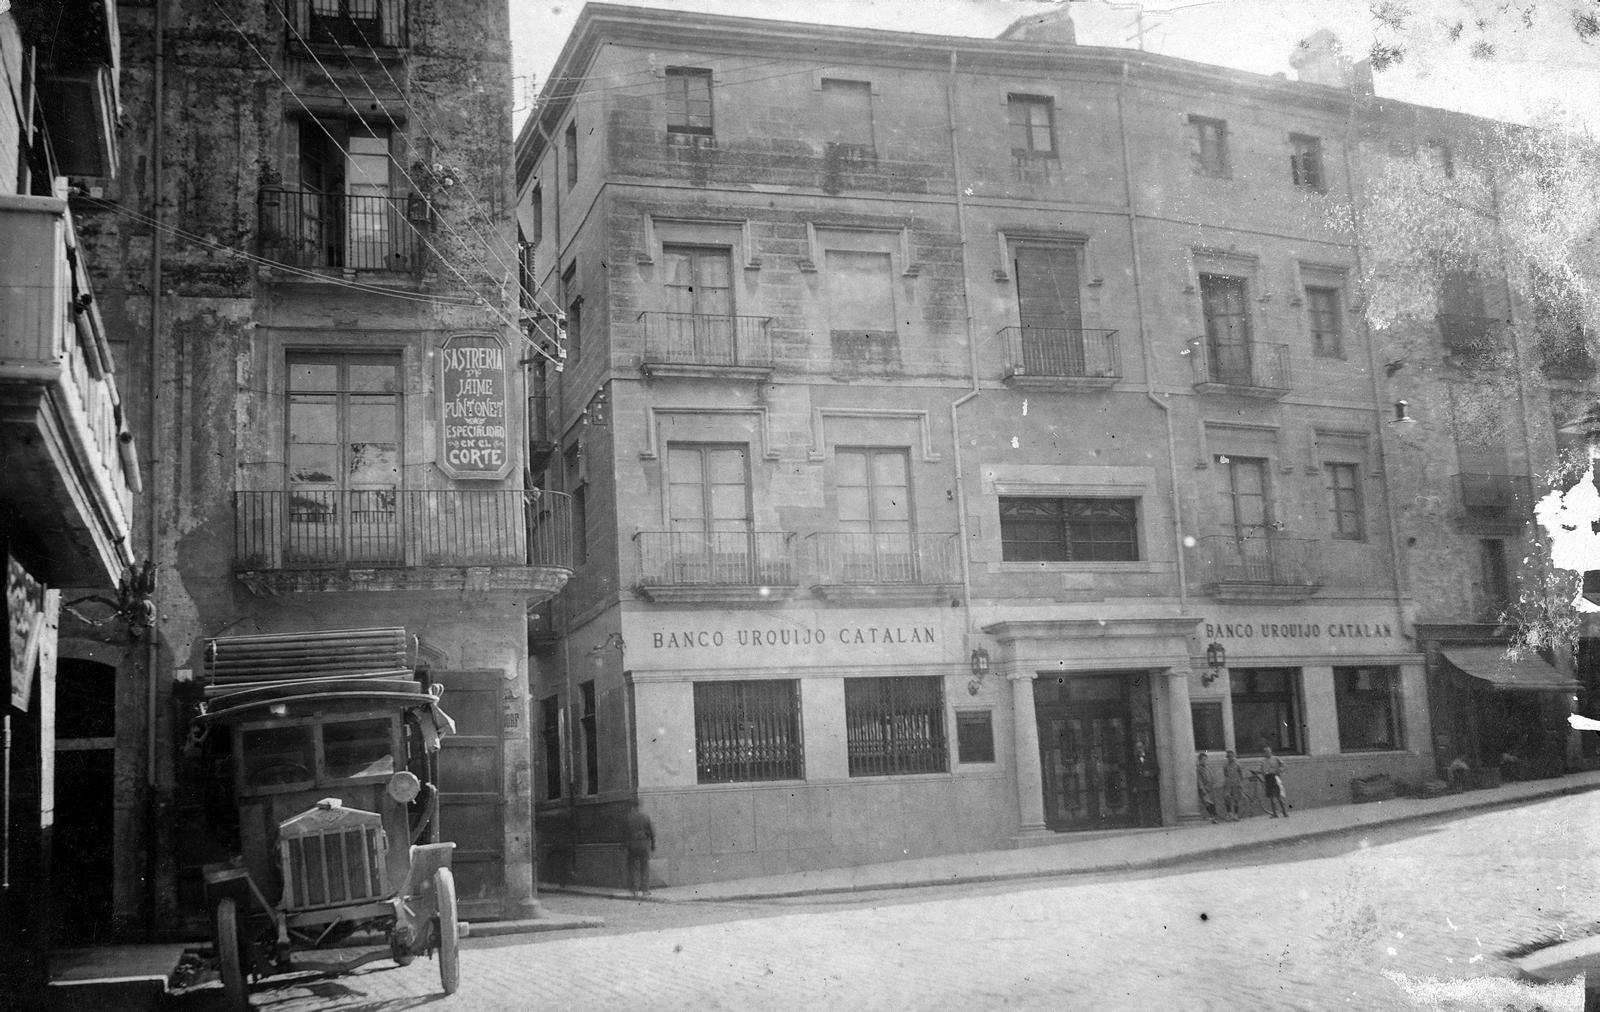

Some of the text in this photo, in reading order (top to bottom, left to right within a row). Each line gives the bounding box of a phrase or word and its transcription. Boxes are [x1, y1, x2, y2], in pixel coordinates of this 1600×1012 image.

[444, 347, 502, 372] SASTRERIA
[465, 370, 482, 378] DE
[456, 378, 493, 397] JAIME
[445, 398, 503, 418] PUNTONET
[446, 425, 504, 438] ESPECIALIDAD
[461, 439, 492, 448] EN EL
[450, 449, 502, 468] CORTE
[653, 627, 936, 648] BANCO URQUIJO CATALAN
[1206, 623, 1392, 638] BANCO URQUIJO CATALAN
